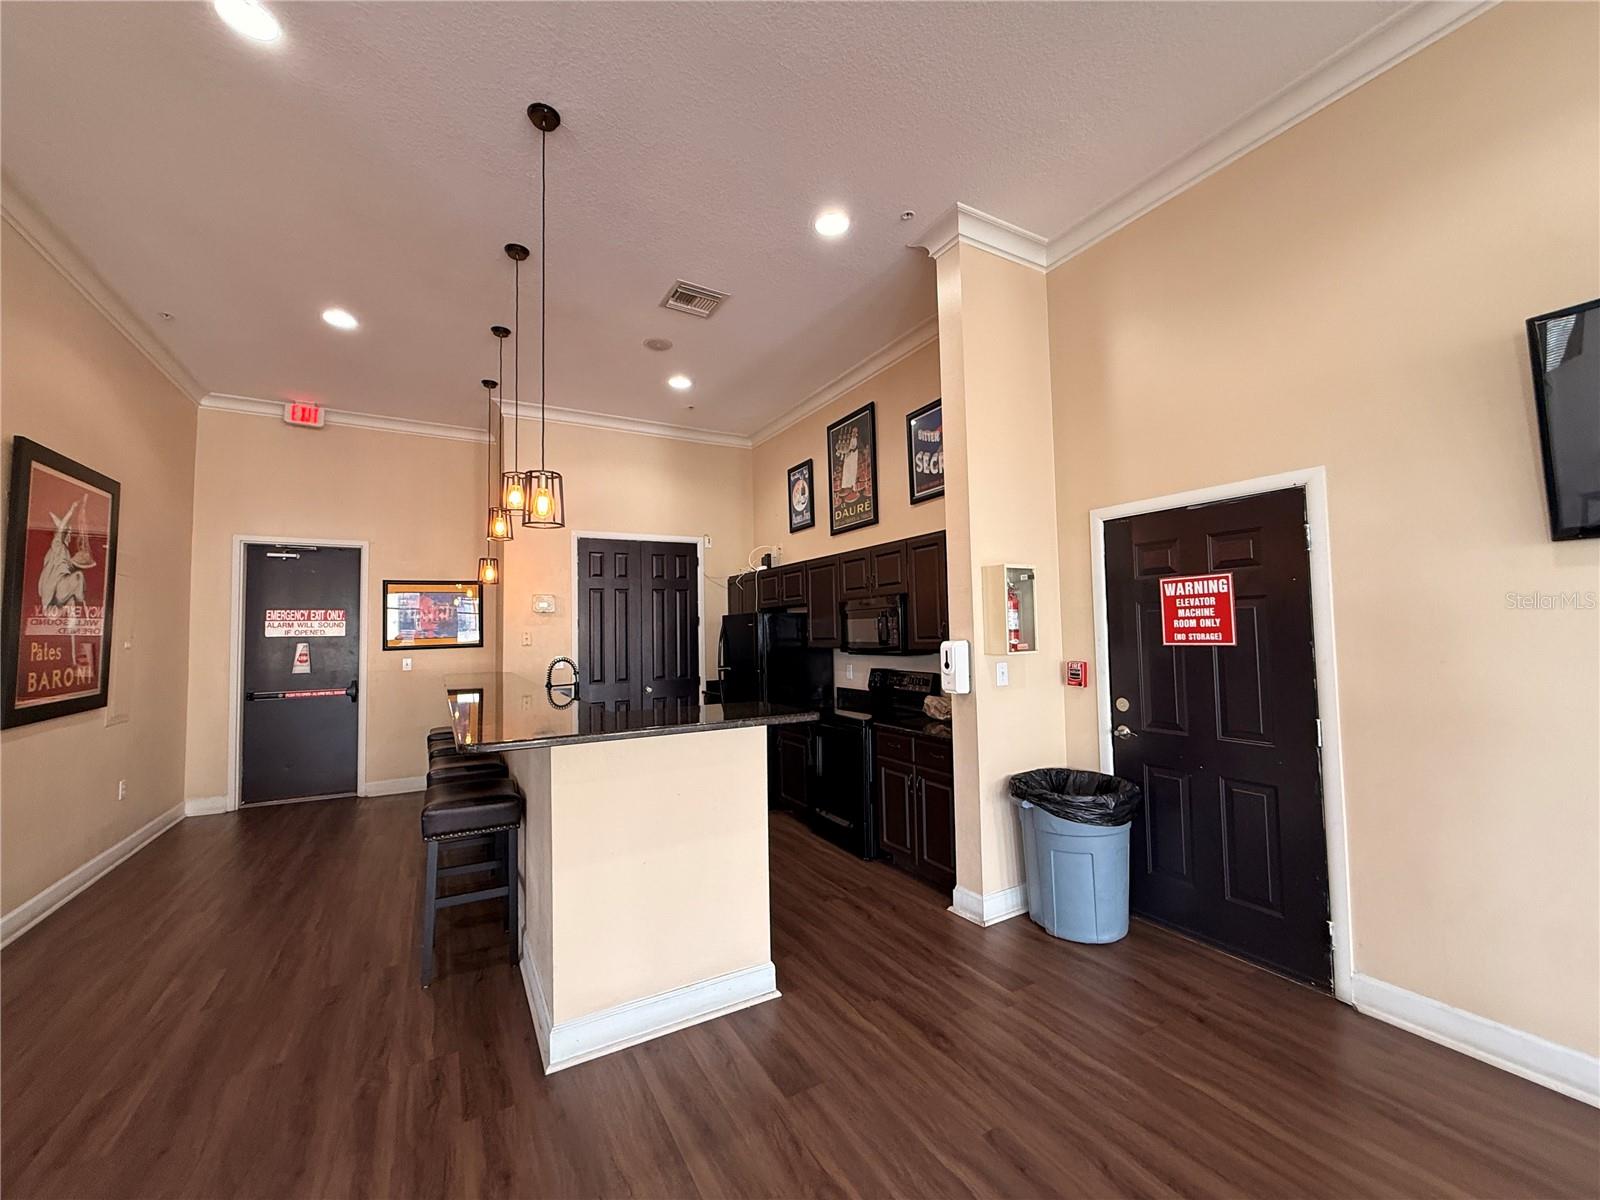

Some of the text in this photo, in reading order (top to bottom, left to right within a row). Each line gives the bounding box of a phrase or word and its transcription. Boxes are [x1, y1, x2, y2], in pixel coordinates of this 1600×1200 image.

[292, 405, 319, 424] EXIT
[1164, 579, 1228, 596] WARNING
[1176, 597, 1216, 607] ELEVATOR
[266, 609, 309, 620] EMERGENCY
[310, 609, 325, 620] EXIT
[1177, 607, 1216, 617] MACHINE
[1173, 618, 1221, 628] ROOM ONLY
[27, 664, 92, 693] BARONI
